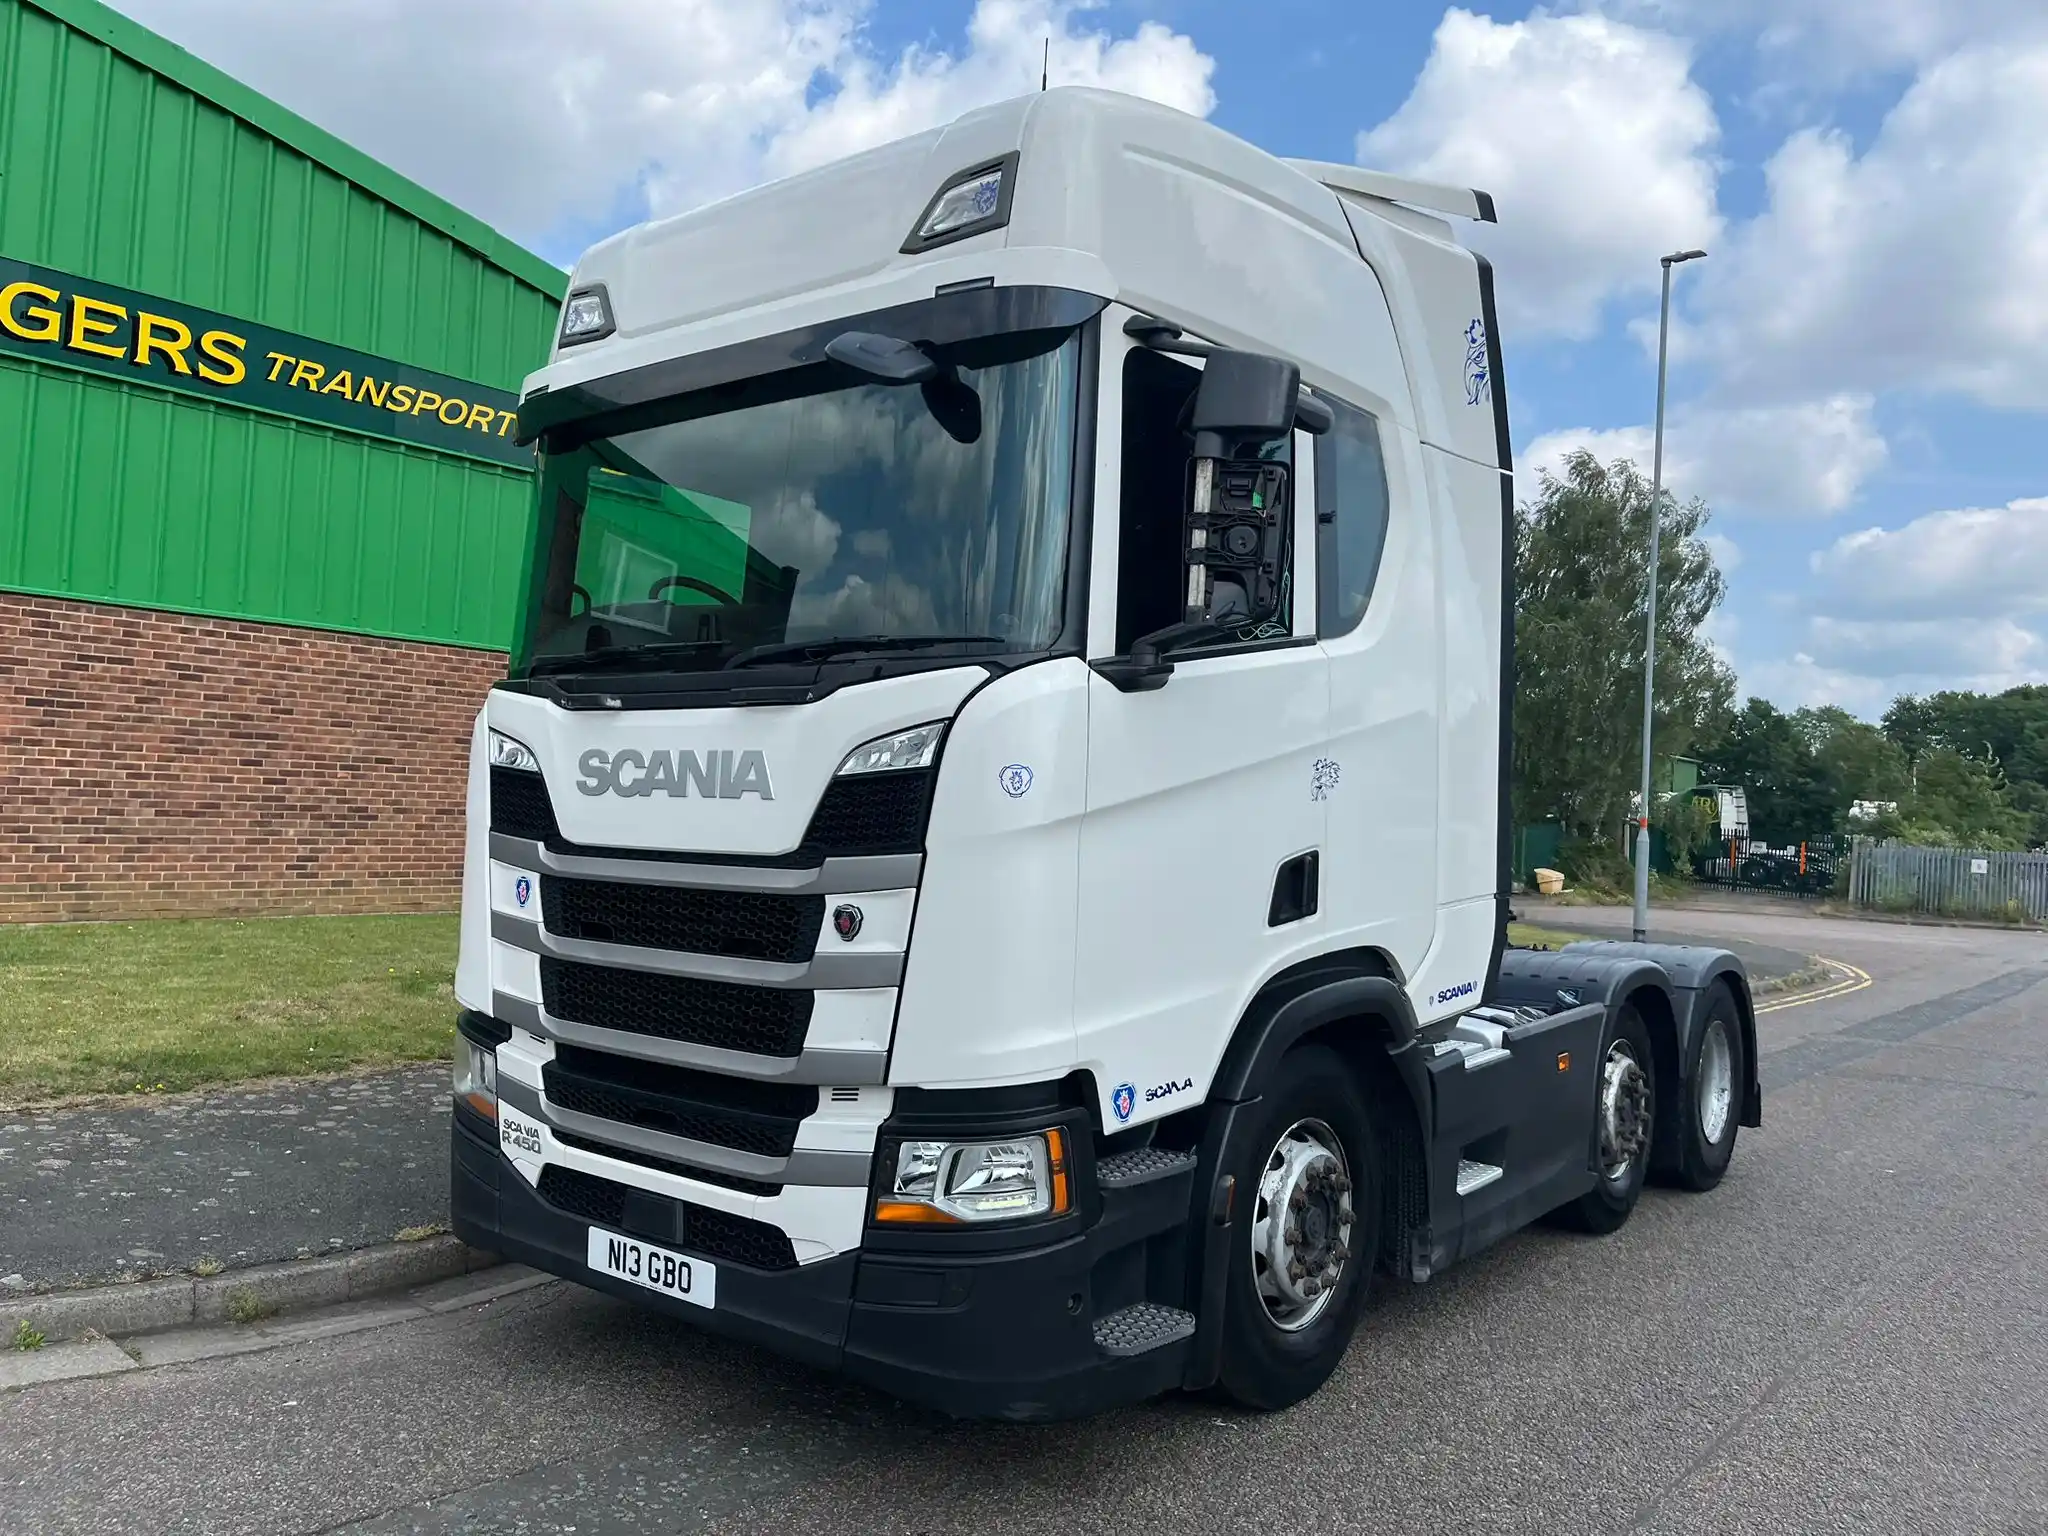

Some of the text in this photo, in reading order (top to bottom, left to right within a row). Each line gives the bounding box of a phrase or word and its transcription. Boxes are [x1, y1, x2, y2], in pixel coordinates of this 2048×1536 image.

[266, 351, 517, 436] TRANSPORT
[576, 748, 775, 800] SCANIA
[1437, 982, 1473, 1004] SCANIA
[501, 1129, 541, 1155] R 450
[608, 1238, 641, 1278] N13
